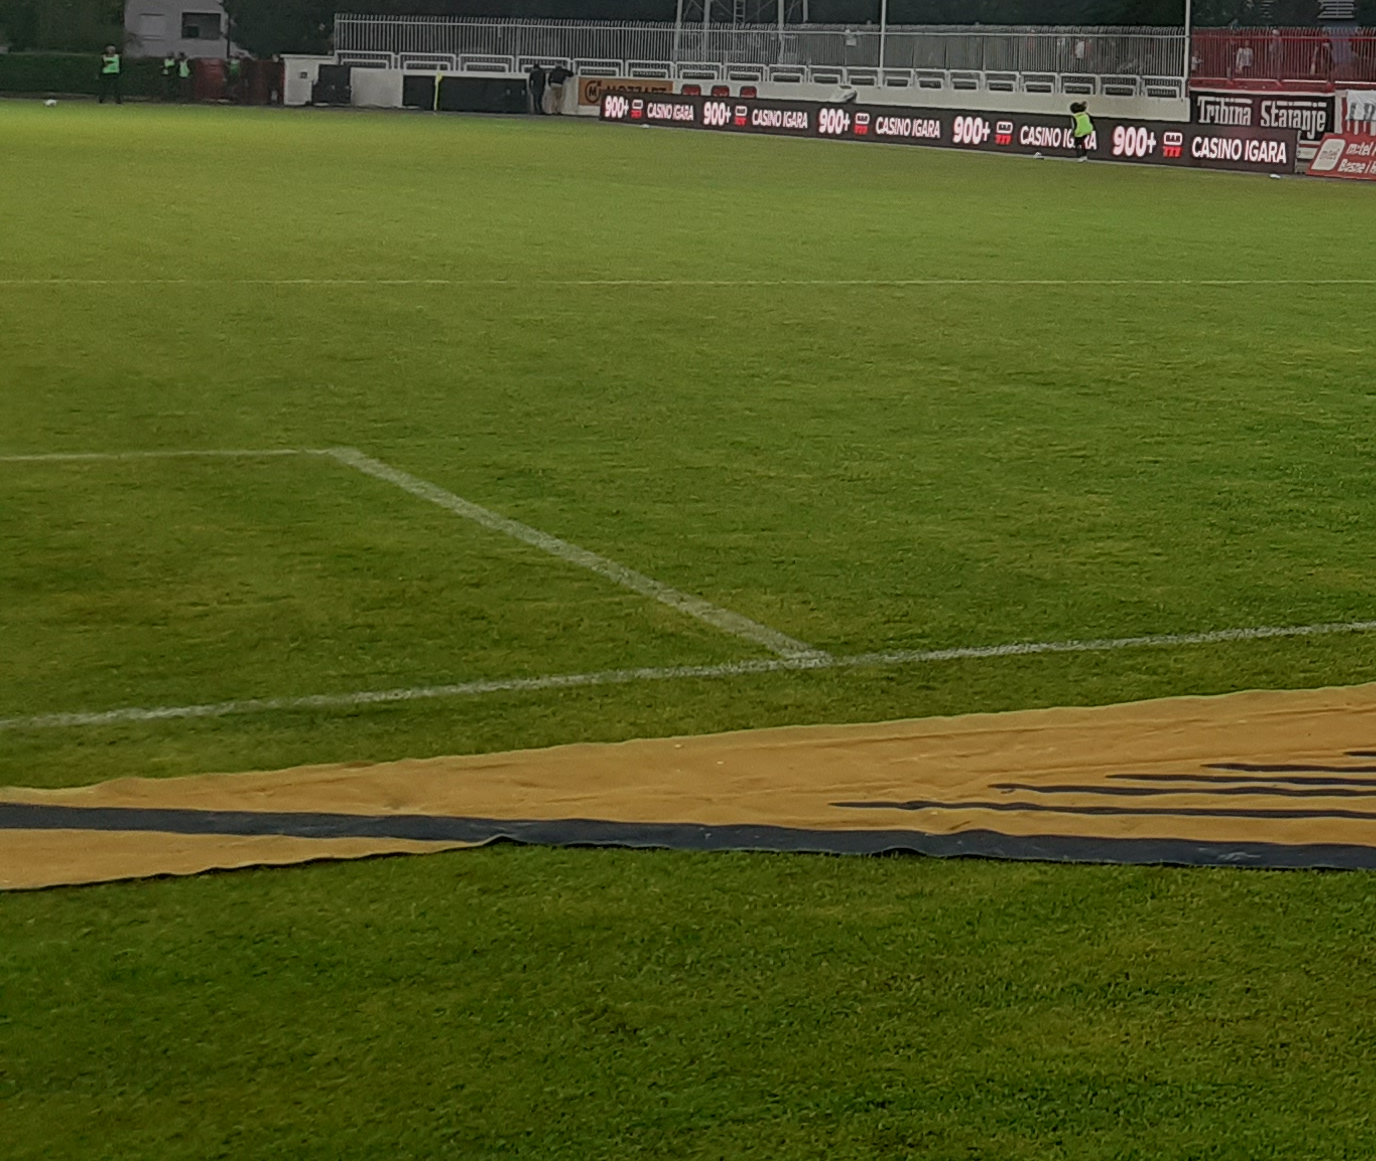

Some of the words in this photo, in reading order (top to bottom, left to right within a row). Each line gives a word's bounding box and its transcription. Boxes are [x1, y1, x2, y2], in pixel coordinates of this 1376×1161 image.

[1197, 96, 1253, 126] Tribina
[875, 116, 912, 137] CASINO
[911, 118, 941, 138] IGARA
[952, 115, 991, 145] 900+
[1020, 125, 1062, 148] CASINO
[1062, 128, 1097, 150] IGRA
[1113, 125, 1157, 157] 900+
[1191, 136, 1242, 161] CASINO
[1244, 139, 1287, 164] IGARA
